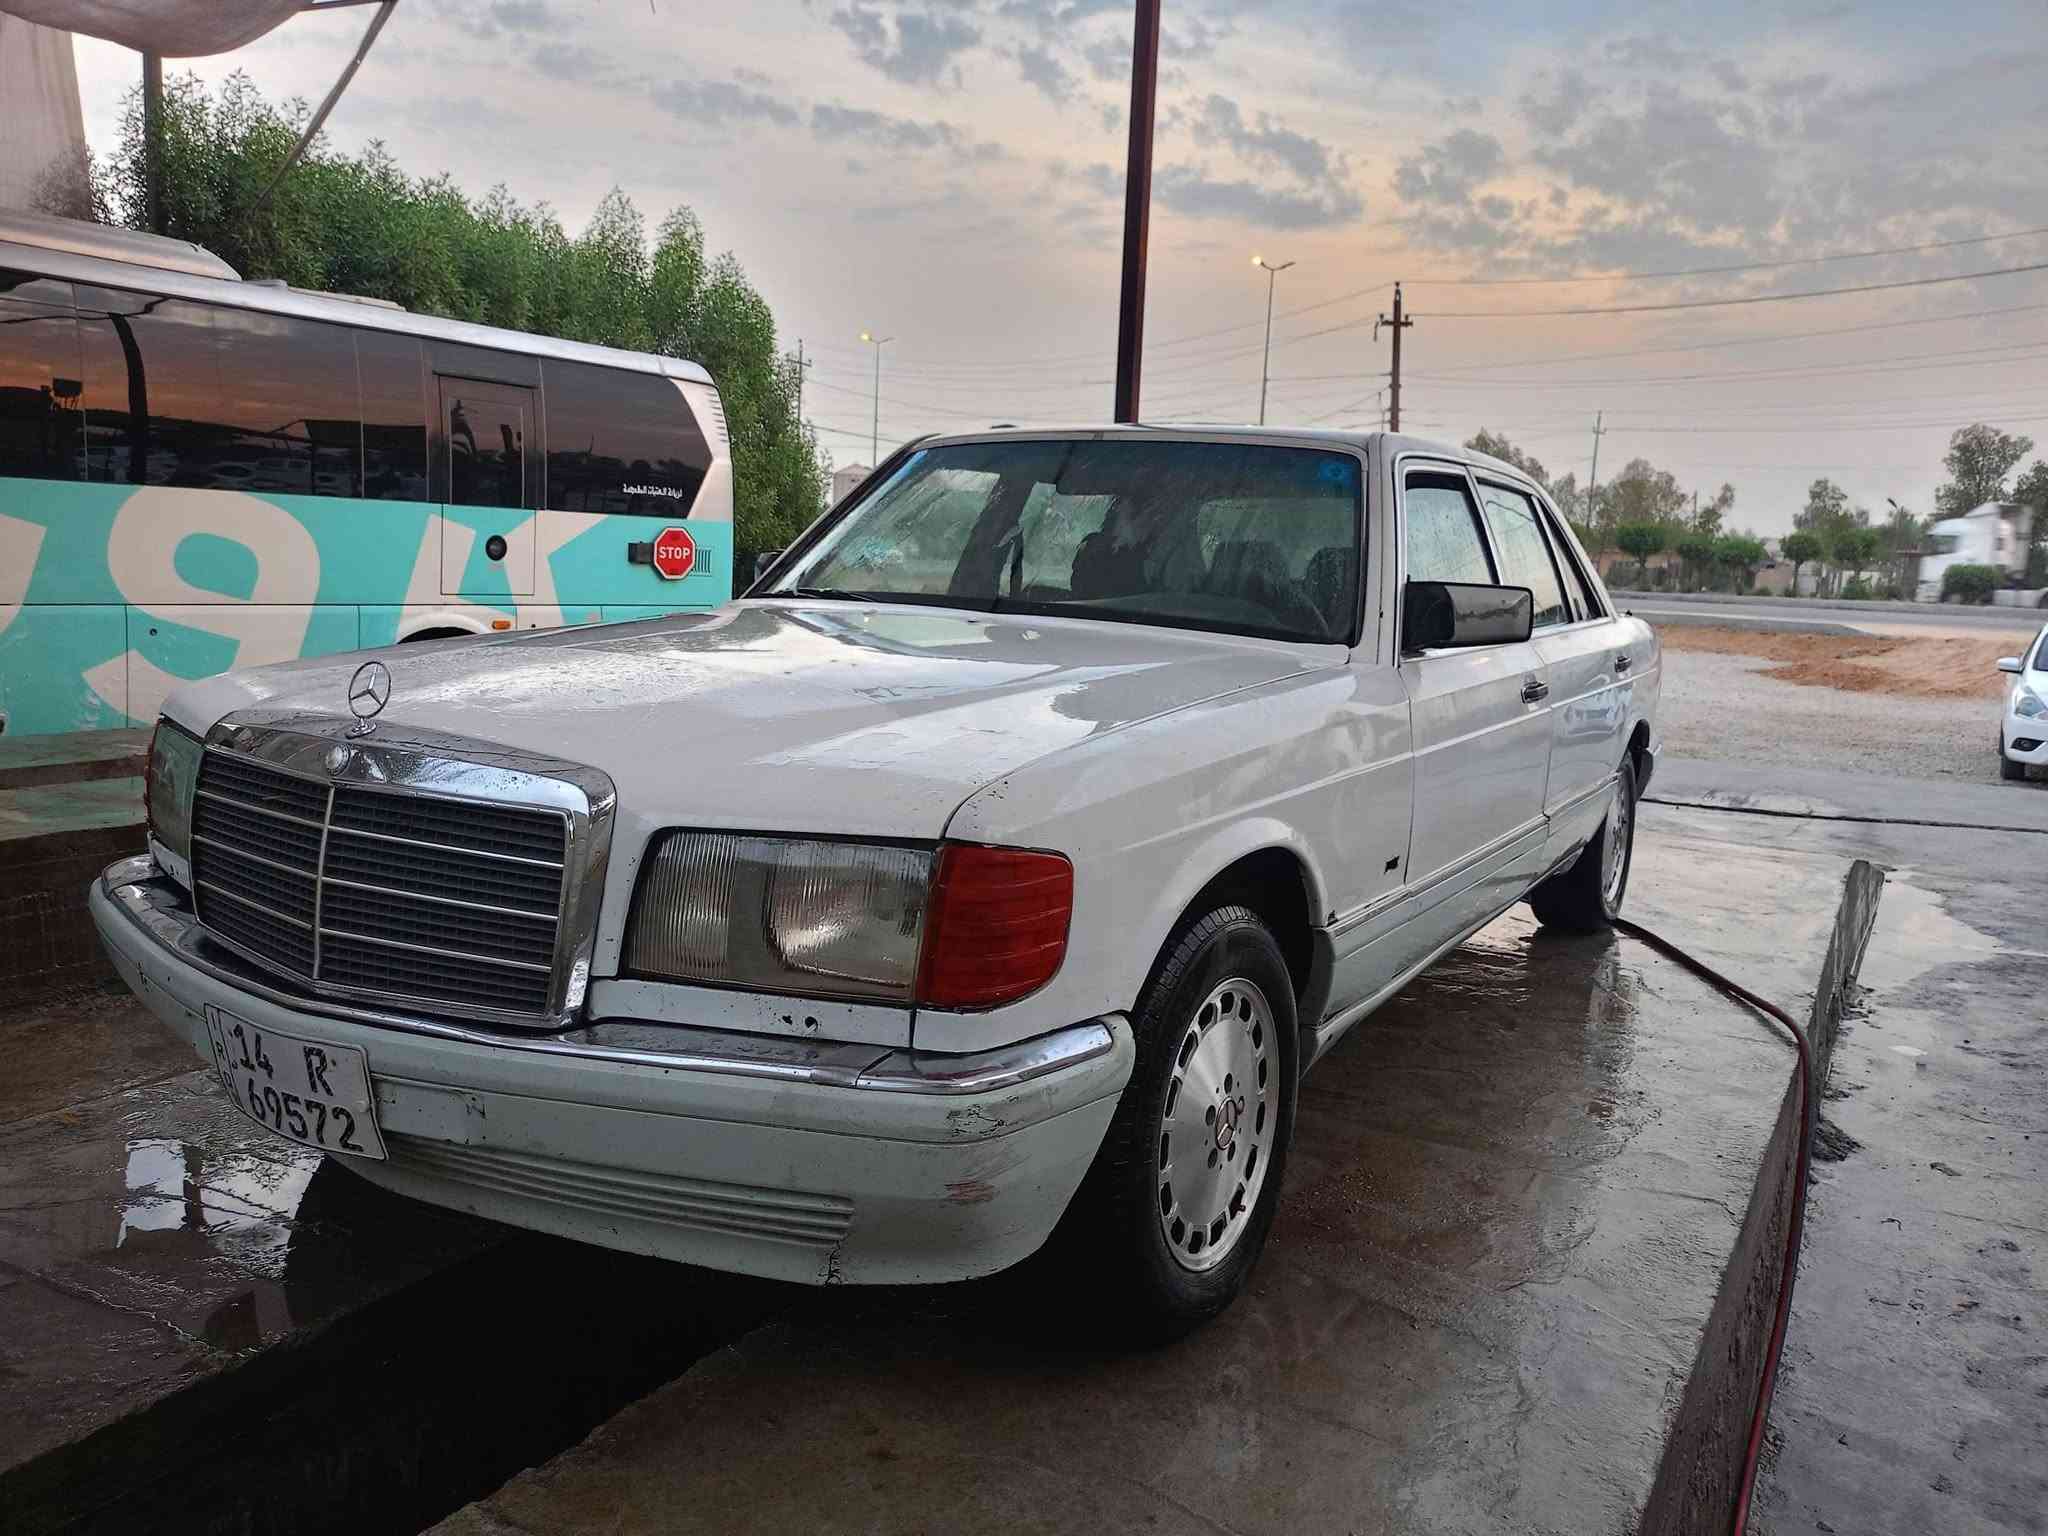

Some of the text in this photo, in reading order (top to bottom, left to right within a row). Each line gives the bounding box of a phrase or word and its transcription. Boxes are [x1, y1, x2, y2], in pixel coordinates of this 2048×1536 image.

[658, 546, 691, 560] STOP
[231, 1022, 335, 1097] 14 R
[247, 1076, 364, 1153] 69572
